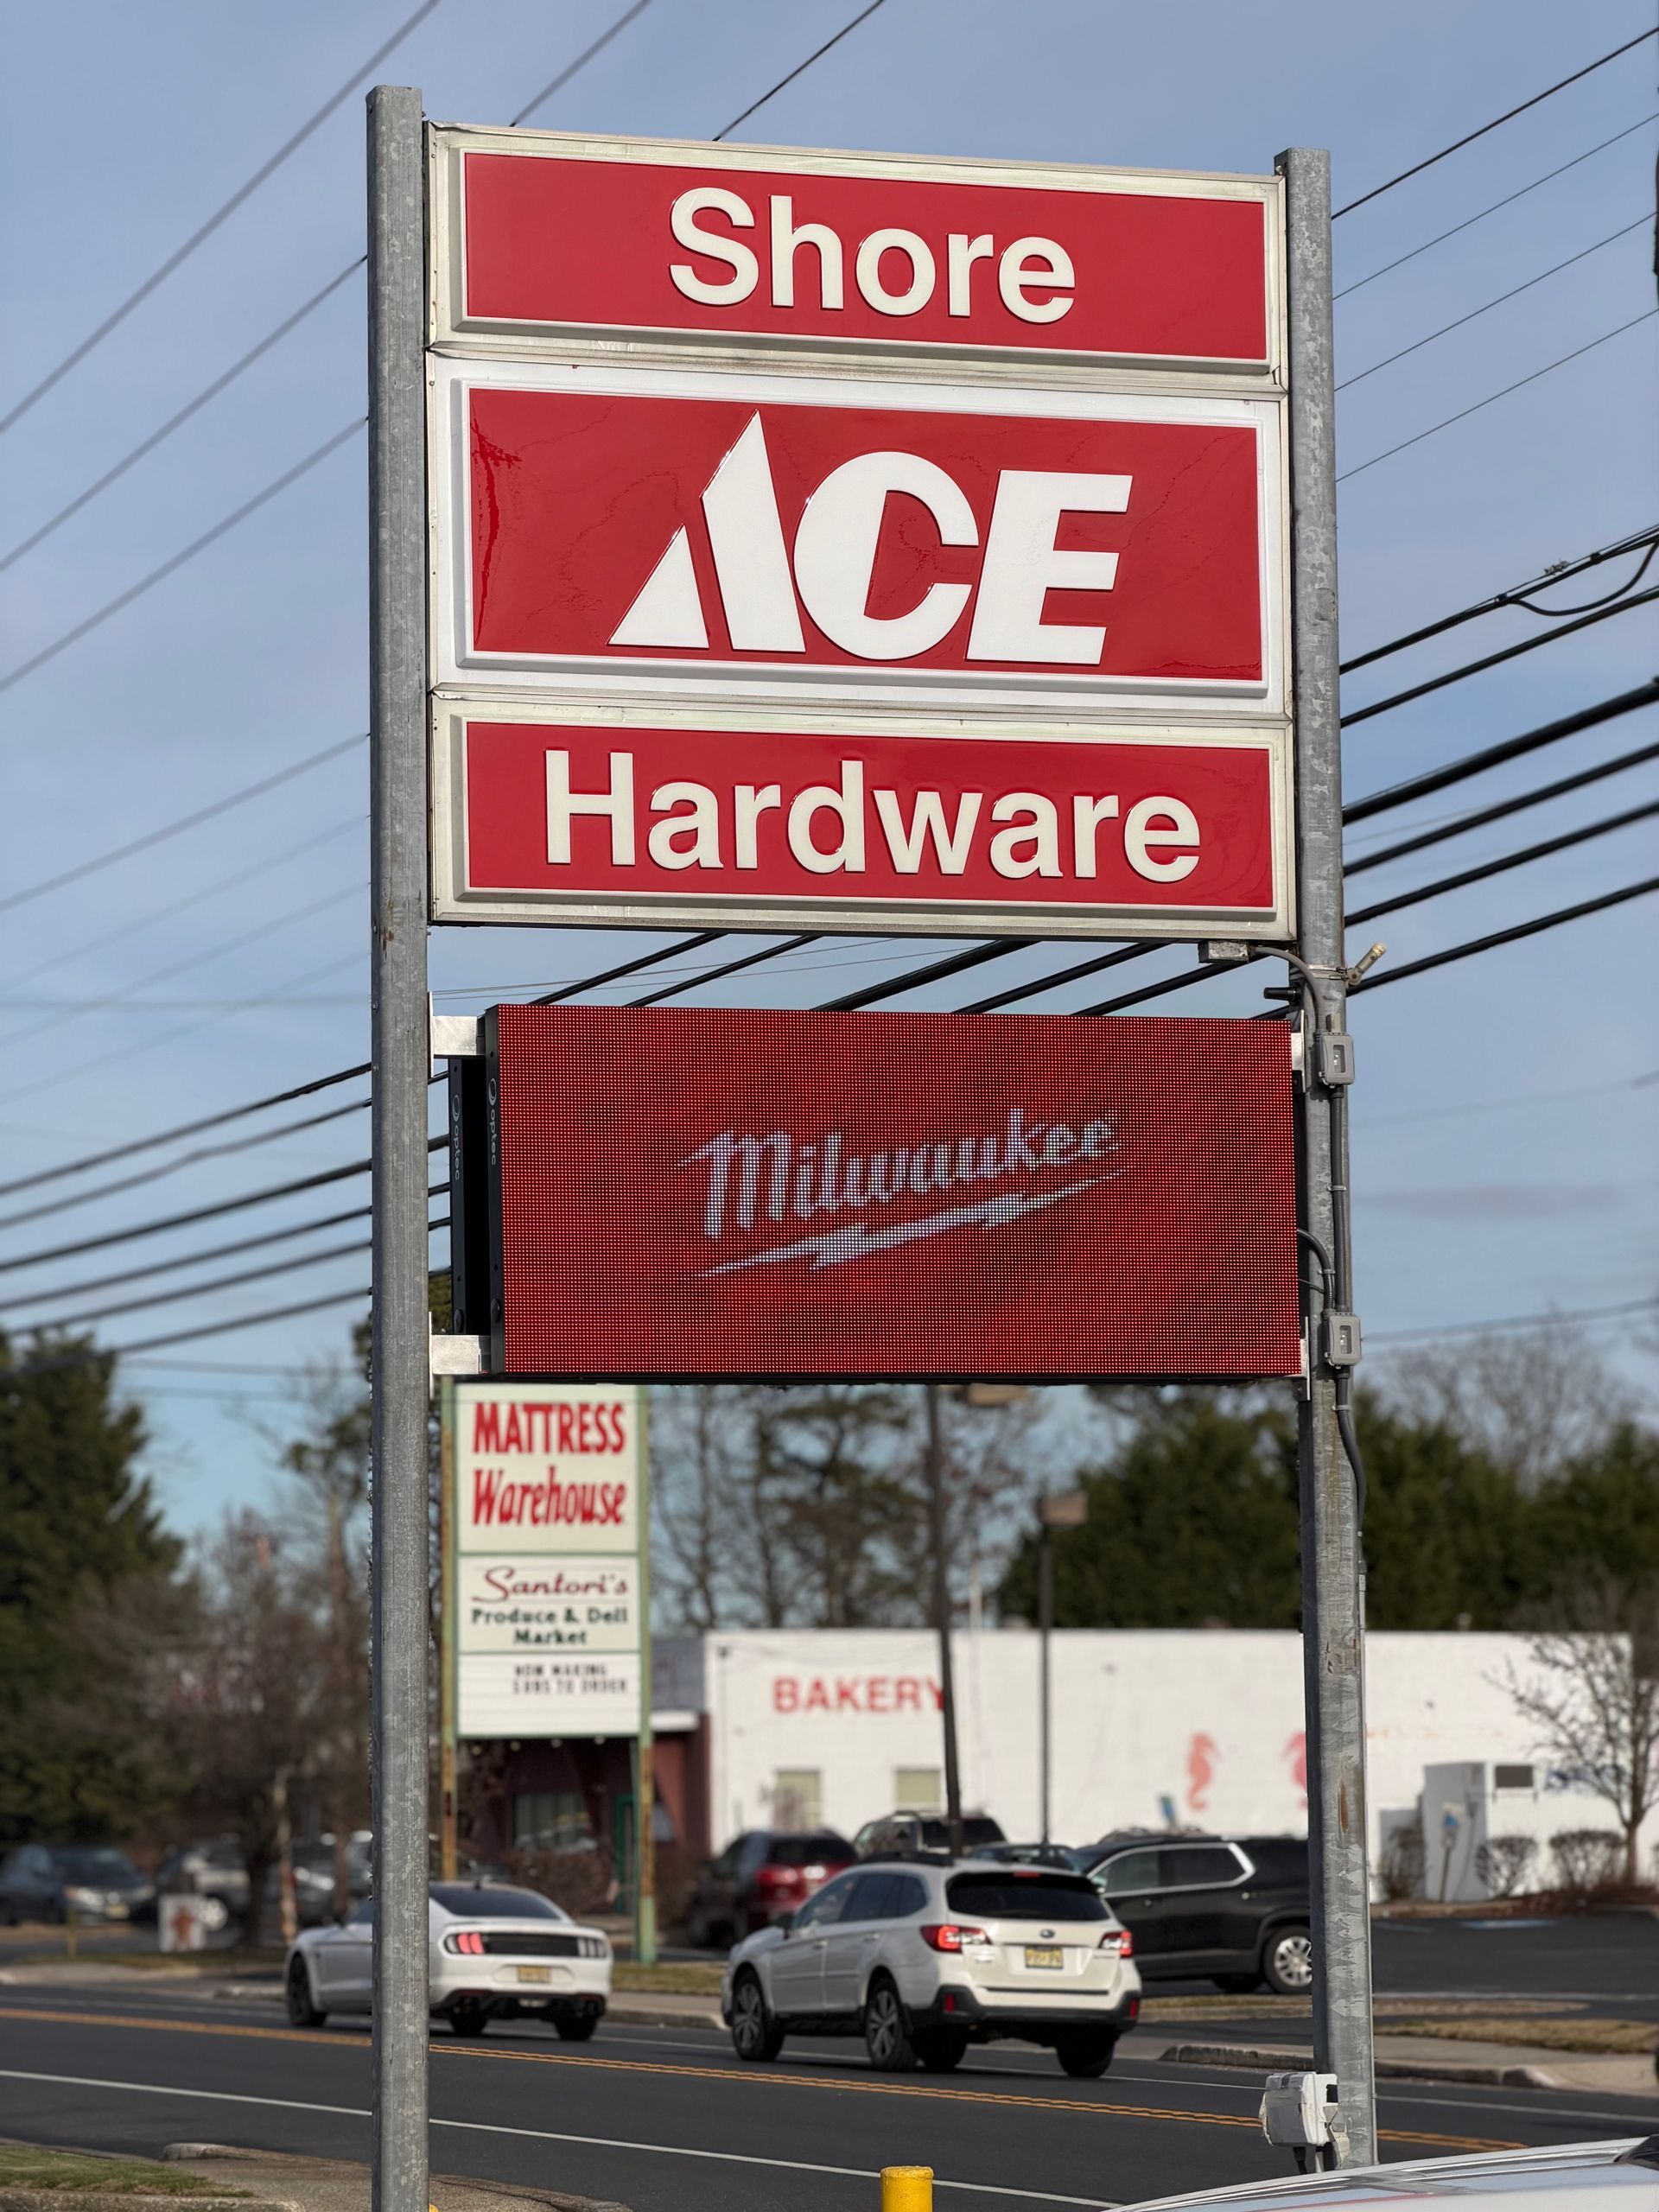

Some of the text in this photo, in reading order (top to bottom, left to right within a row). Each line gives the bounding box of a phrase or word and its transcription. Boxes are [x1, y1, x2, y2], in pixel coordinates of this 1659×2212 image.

[668, 187, 1076, 324] Shore
[607, 410, 1134, 664] ACE
[543, 749, 1201, 884] Hardware
[452, 1124, 461, 1181] optec
[676, 1107, 1122, 1239] Milwaukee
[473, 1402, 626, 1455] MATTRESS
[472, 1465, 626, 1526] Warehouse
[471, 1566, 627, 1604] Santori's
[472, 1608, 556, 1624] Produce
[564, 1608, 579, 1623] &
[514, 1629, 587, 1645] Market
[772, 1675, 944, 1713] BAKERY
